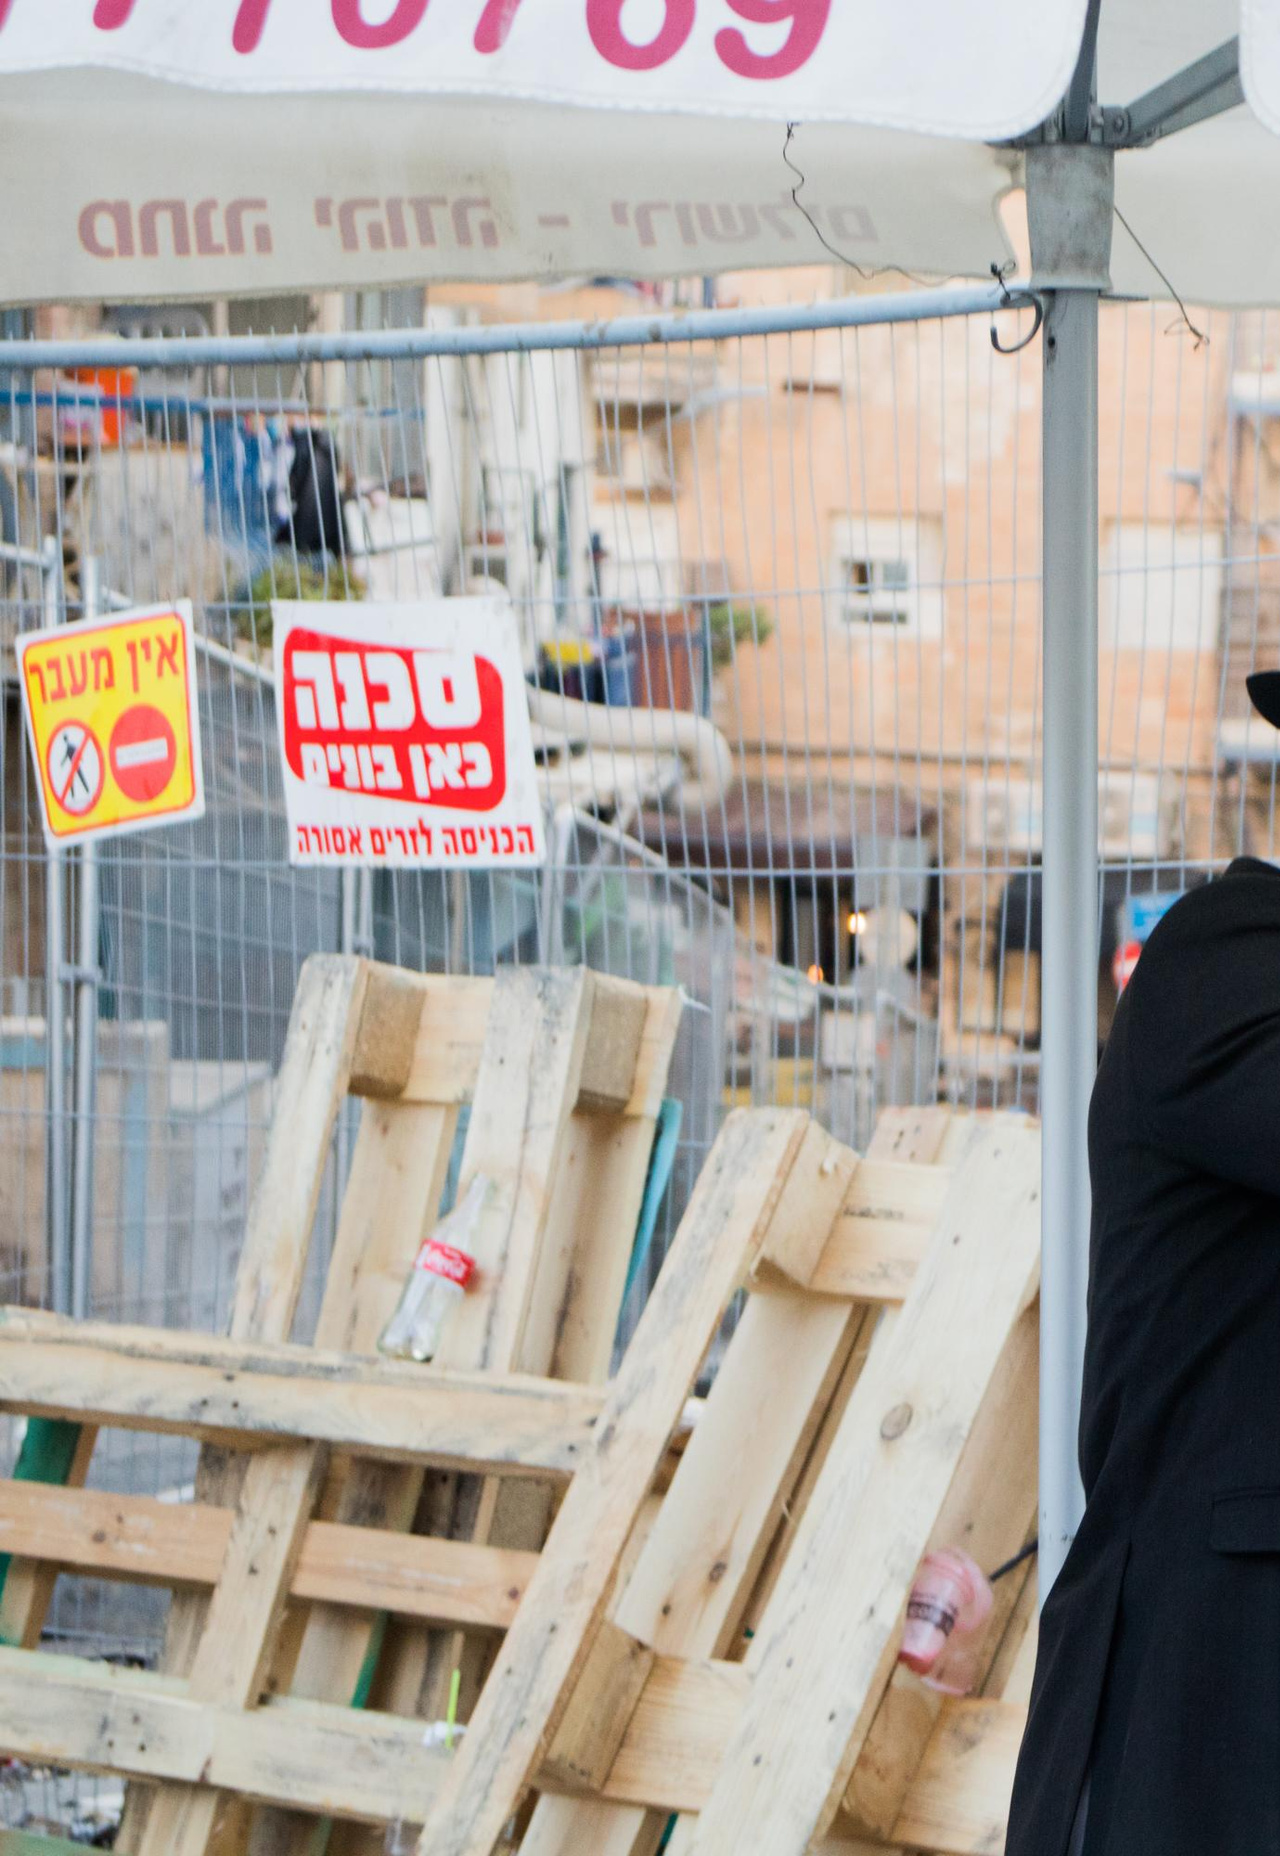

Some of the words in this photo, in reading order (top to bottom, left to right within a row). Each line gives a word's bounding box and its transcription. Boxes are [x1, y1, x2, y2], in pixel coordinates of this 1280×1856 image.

[29, 647, 115, 704] מעבר
[126, 631, 180, 693] אין
[291, 650, 482, 731] סכנה
[300, 743, 403, 789] בונים
[409, 742, 493, 799] כאן
[297, 824, 363, 857] אסורה
[369, 816, 432, 857] לזרים
[441, 824, 535, 856] הכניסה
